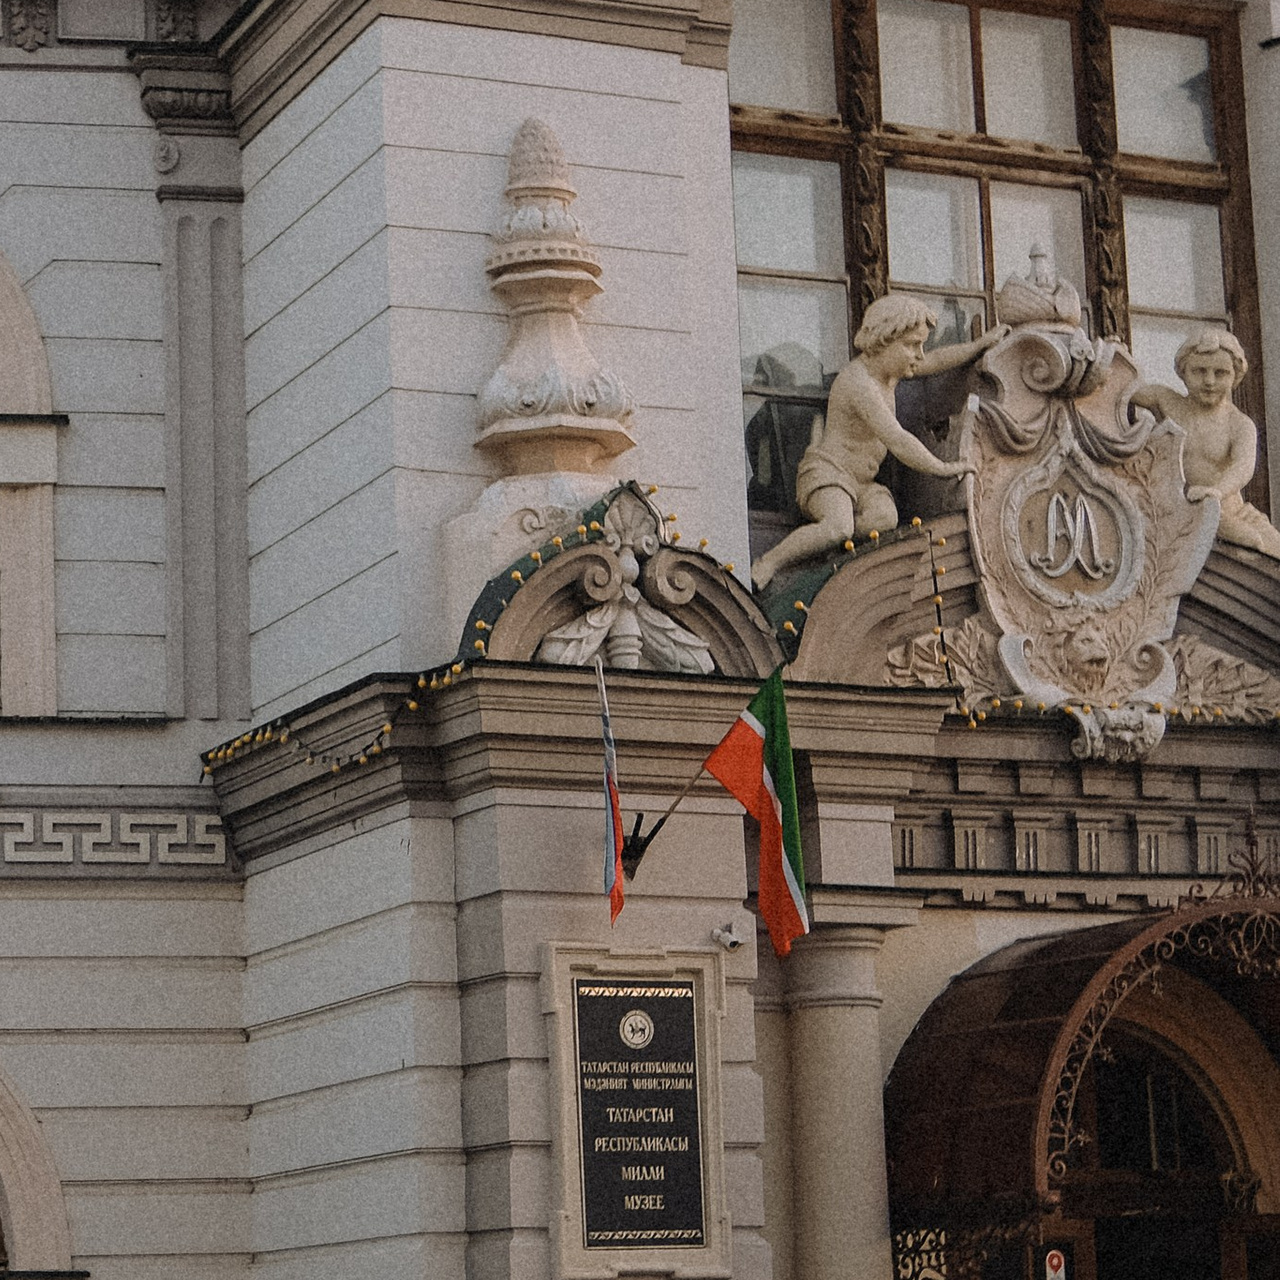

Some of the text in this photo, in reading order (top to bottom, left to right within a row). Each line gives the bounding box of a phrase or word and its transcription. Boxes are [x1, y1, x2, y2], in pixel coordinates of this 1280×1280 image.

[606, 1107, 674, 1123] ТАТАРСТАН
[594, 1136, 689, 1152] РЕСПУБЛИКАСЫ
[621, 1165, 665, 1181] МИЛЛИ
[624, 1194, 665, 1210] МУЗЕЕ
